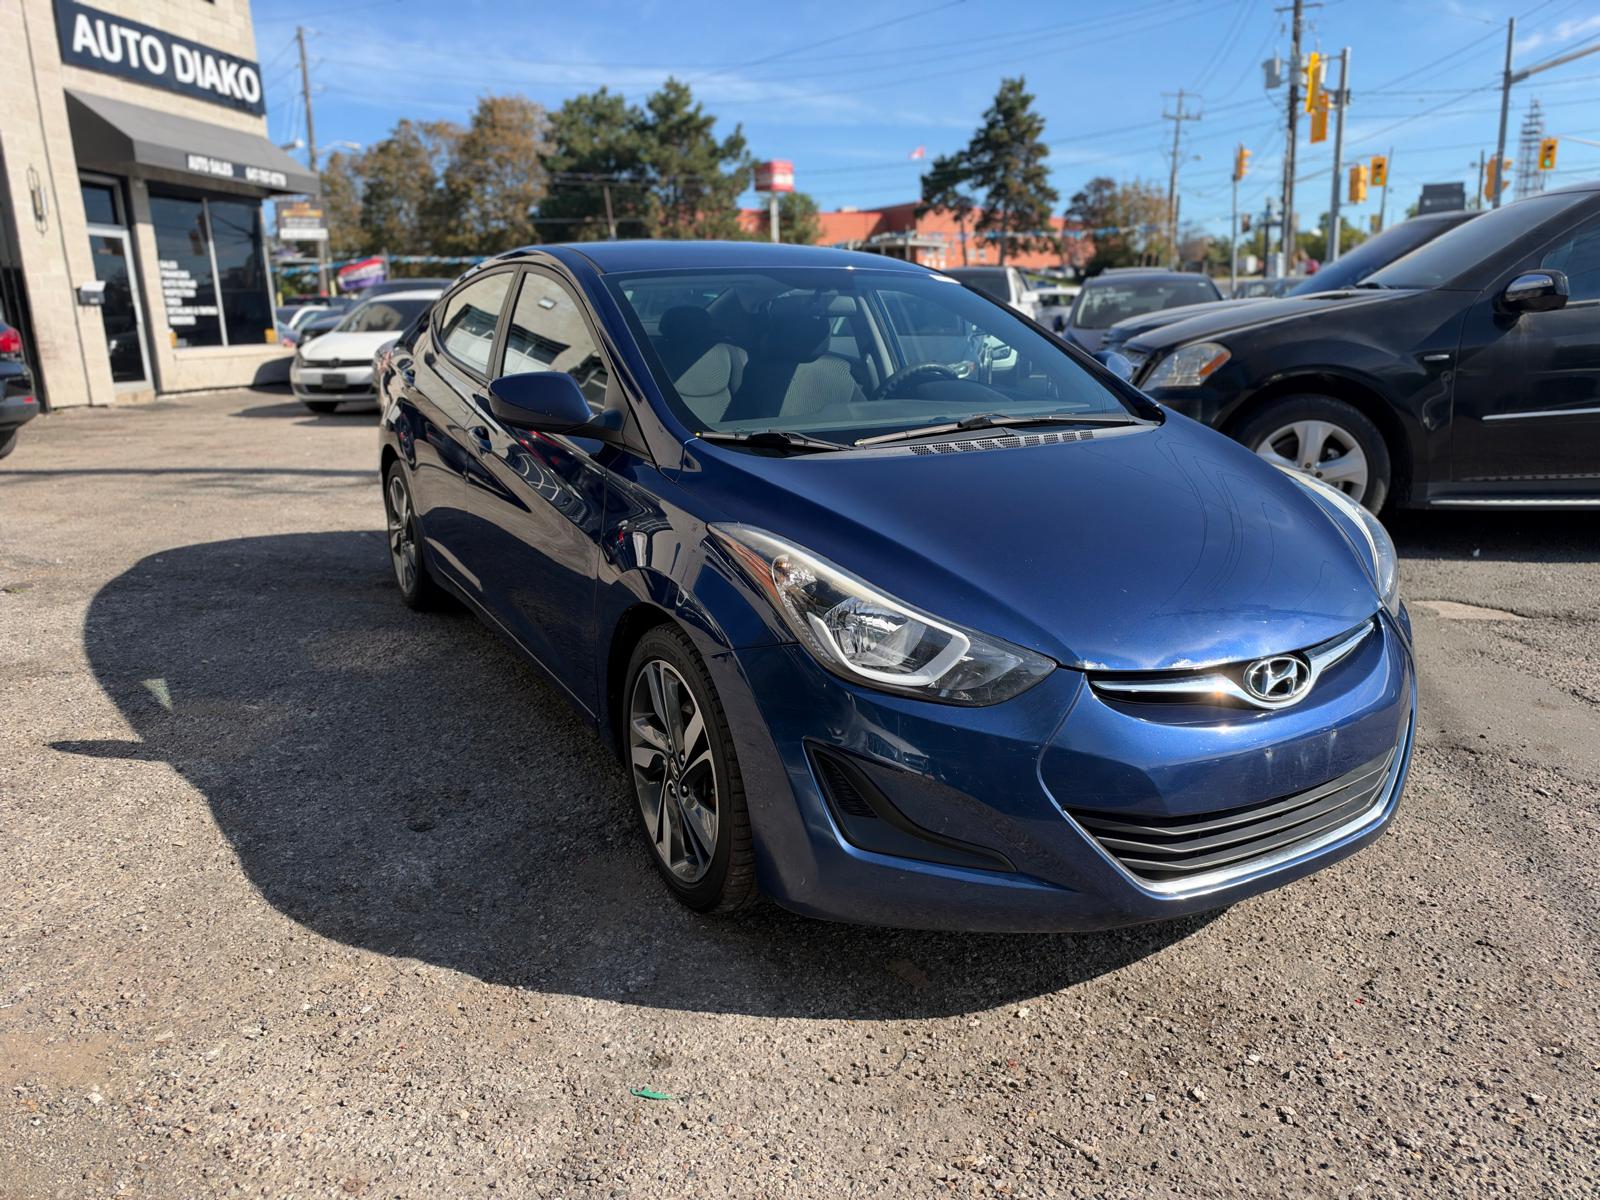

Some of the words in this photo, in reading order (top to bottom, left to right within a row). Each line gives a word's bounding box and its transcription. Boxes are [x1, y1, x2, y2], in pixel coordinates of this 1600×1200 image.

[73, 13, 167, 75] AUTO
[171, 43, 261, 103] DIAKO
[188, 154, 208, 173] AUTO
[209, 158, 233, 177] SALES
